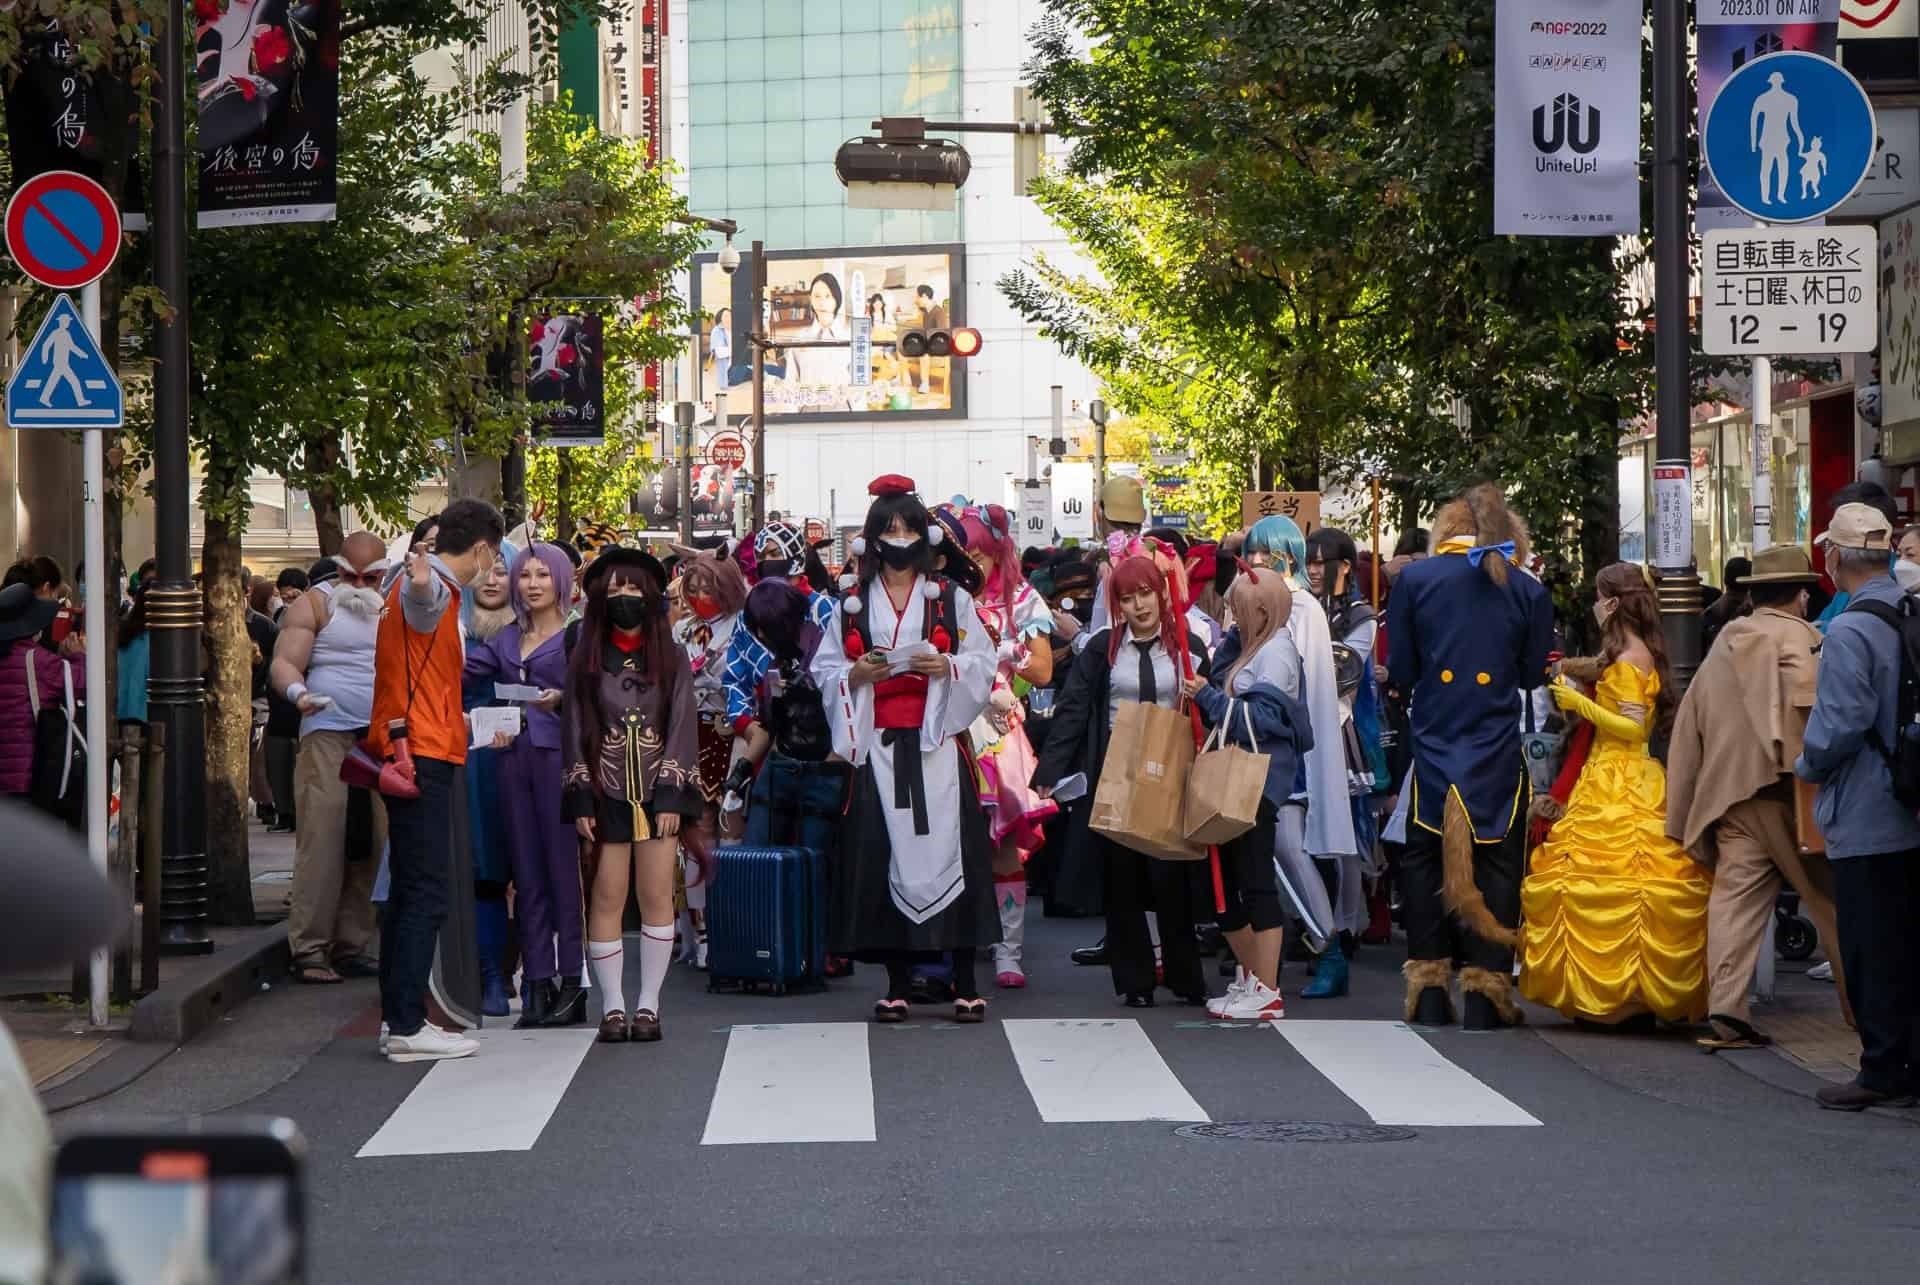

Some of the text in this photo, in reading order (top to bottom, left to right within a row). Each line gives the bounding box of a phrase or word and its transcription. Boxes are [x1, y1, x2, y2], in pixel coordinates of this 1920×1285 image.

[1720, 0, 1820, 16] 2023.01 ON AIR
[1530, 56, 1605, 70] ANIPLEX
[1535, 156, 1597, 173] UniteUp!
[1716, 237, 1861, 270] 自転車を除く
[1729, 314, 1760, 345] 12
[1817, 312, 1847, 343] 19
